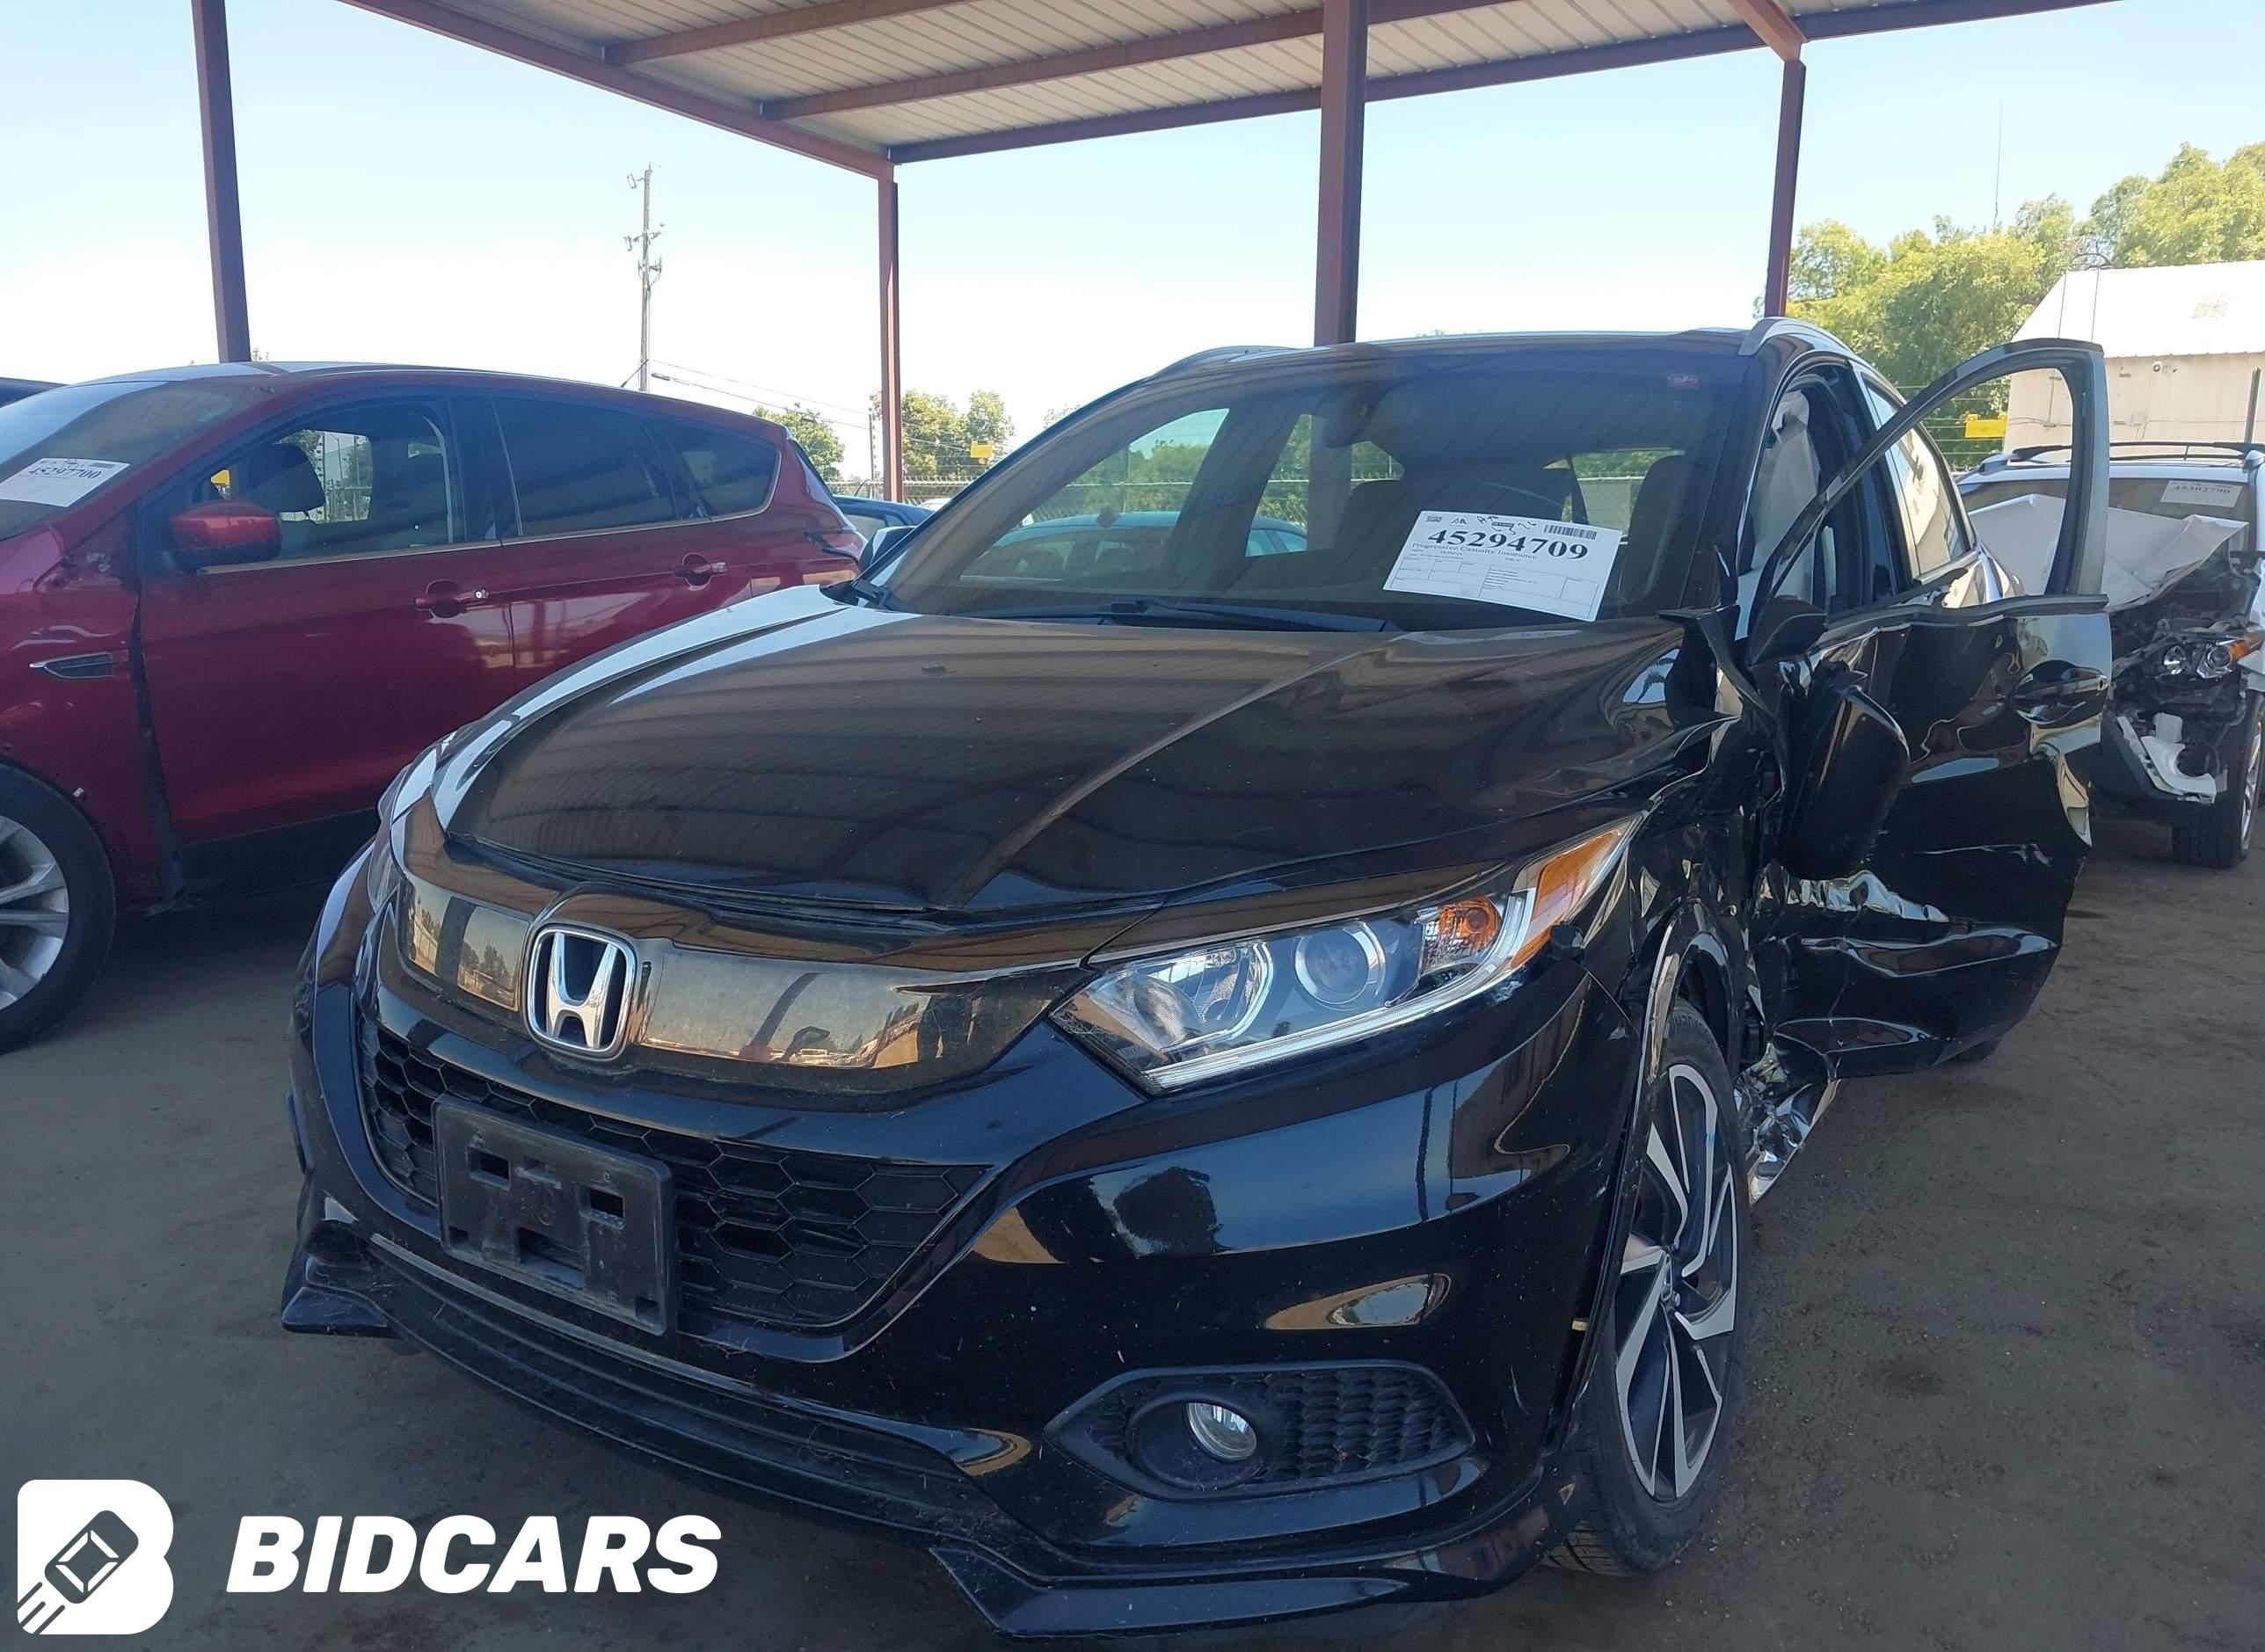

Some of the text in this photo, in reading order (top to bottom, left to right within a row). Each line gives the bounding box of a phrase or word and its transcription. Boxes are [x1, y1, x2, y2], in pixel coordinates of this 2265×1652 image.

[28, 467, 102, 479] 45297700
[1411, 542, 1459, 553] Progressive
[1460, 546, 1495, 556] Casualty
[1497, 549, 1538, 560] Insurance
[1428, 529, 1588, 559] 45294709
